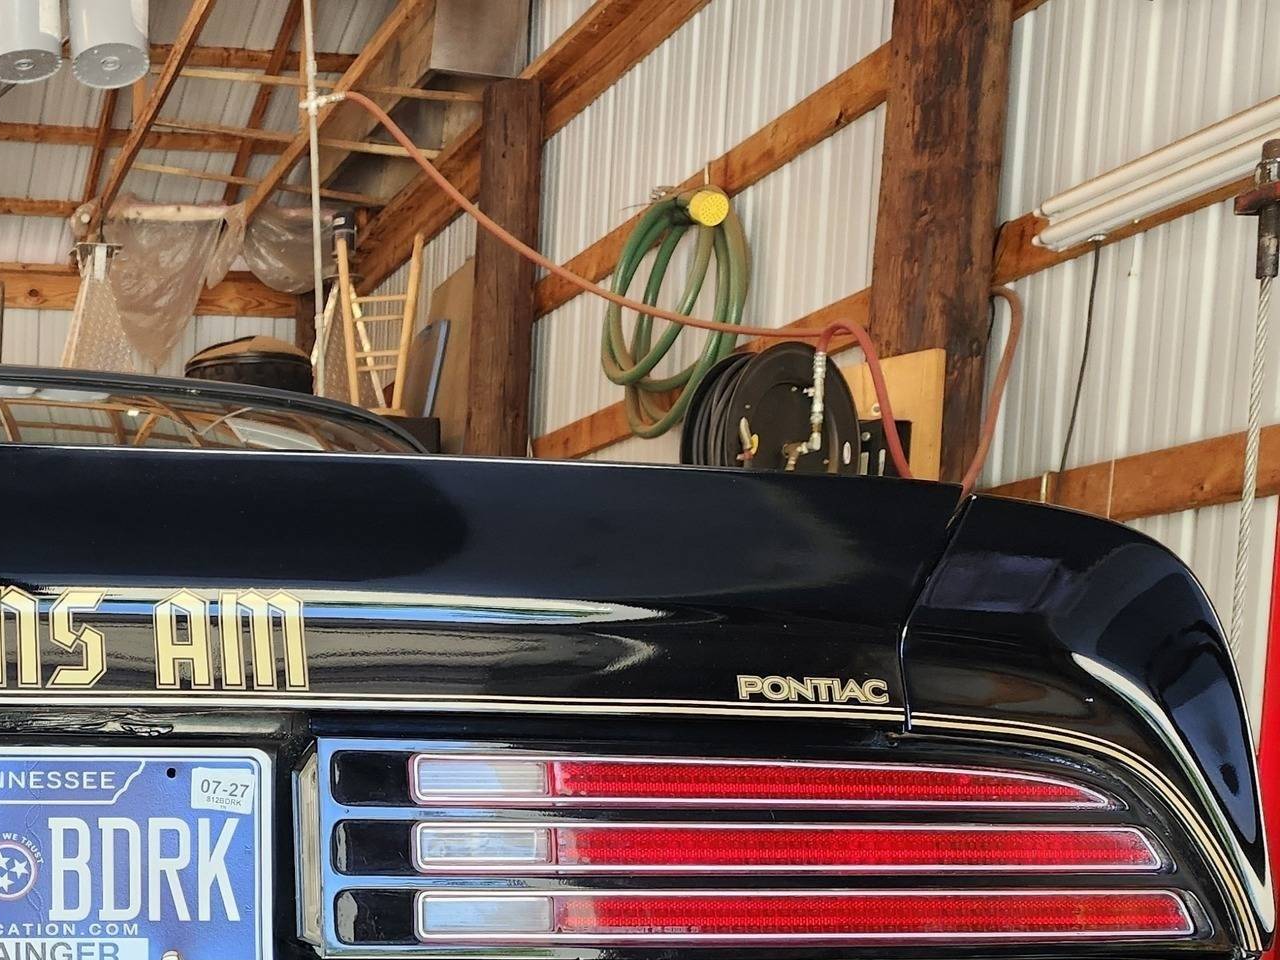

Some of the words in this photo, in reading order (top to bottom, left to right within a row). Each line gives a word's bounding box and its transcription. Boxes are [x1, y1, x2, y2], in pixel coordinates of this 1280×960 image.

[152, 587, 309, 691] AM
[737, 675, 890, 705] PONTIAC
[200, 778, 250, 798] 07-27
[2, 832, 18, 841] WE
[20, 836, 44, 864] TRUST
[48, 817, 241, 922] BDRK
